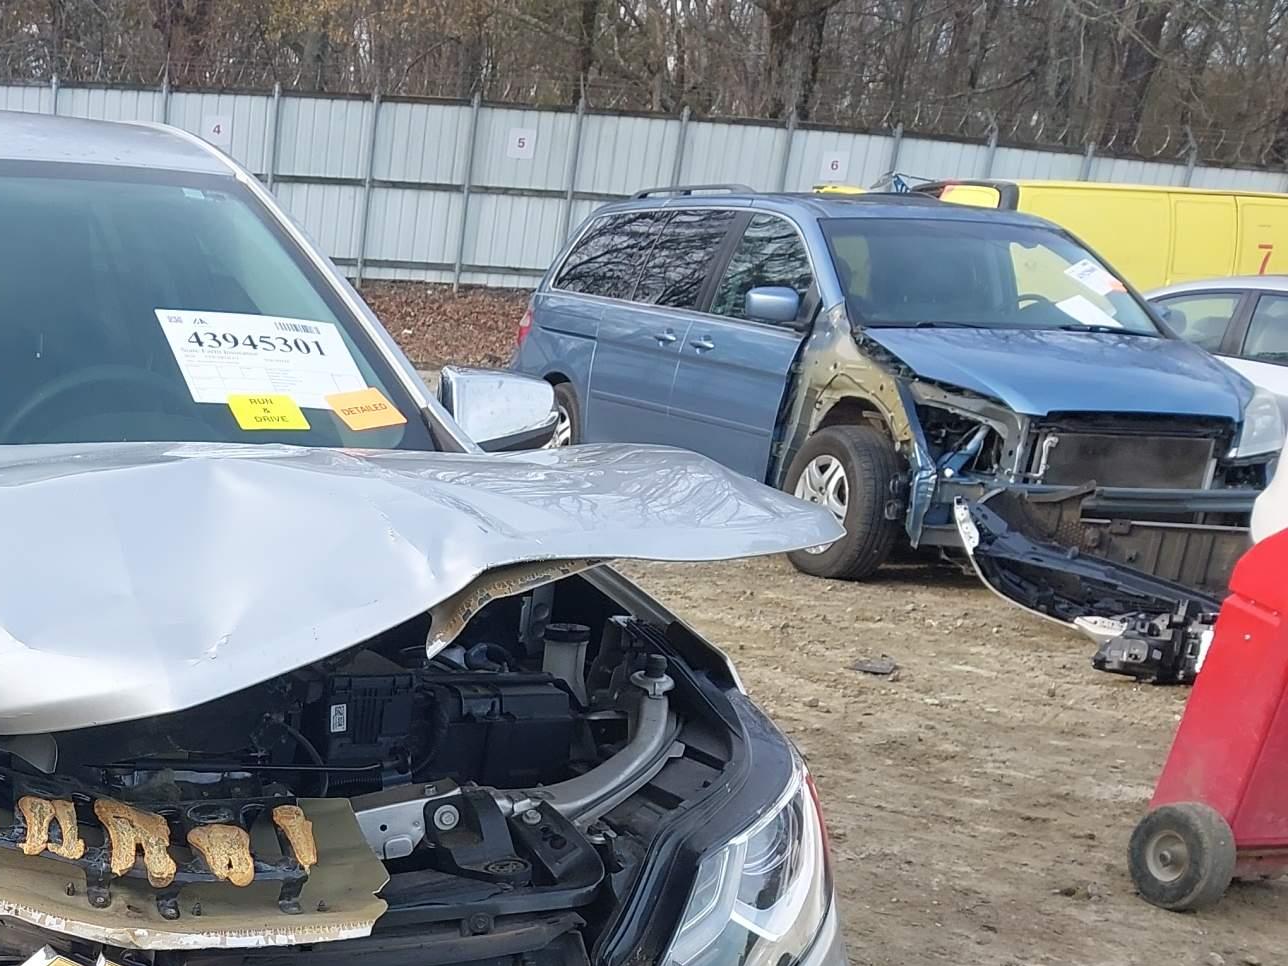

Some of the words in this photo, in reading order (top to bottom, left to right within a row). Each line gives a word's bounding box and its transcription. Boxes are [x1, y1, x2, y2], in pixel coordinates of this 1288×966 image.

[212, 124, 221, 135] 4
[517, 137, 526, 149] 5
[830, 160, 839, 171] 6
[187, 331, 327, 356] 43945301
[248, 397, 274, 406] RUN
[340, 402, 388, 417] DETAILED
[254, 415, 290, 424] DRIVE
